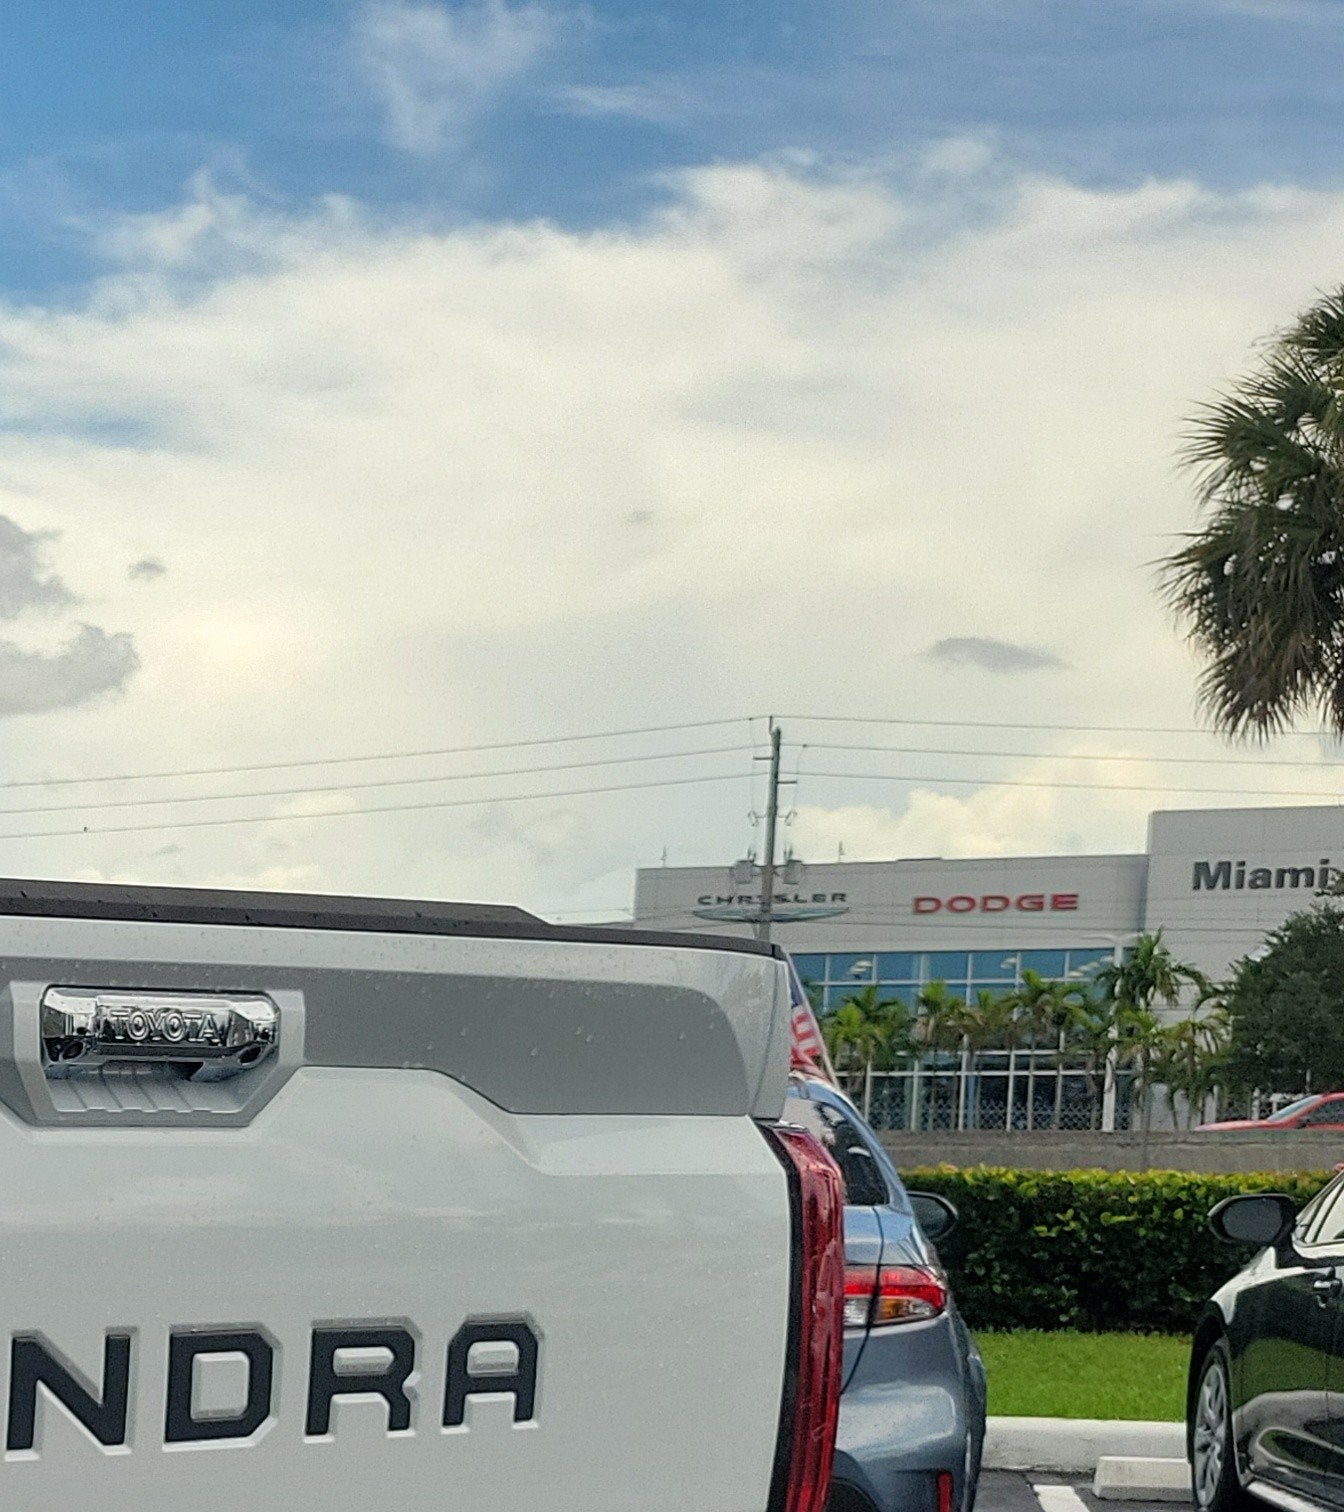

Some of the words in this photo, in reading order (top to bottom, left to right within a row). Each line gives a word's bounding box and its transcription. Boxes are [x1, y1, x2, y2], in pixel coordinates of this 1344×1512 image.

[1192, 858, 1330, 891] Miami
[913, 893, 1079, 914] DODGE
[111, 1008, 221, 1043] TOYOTA
